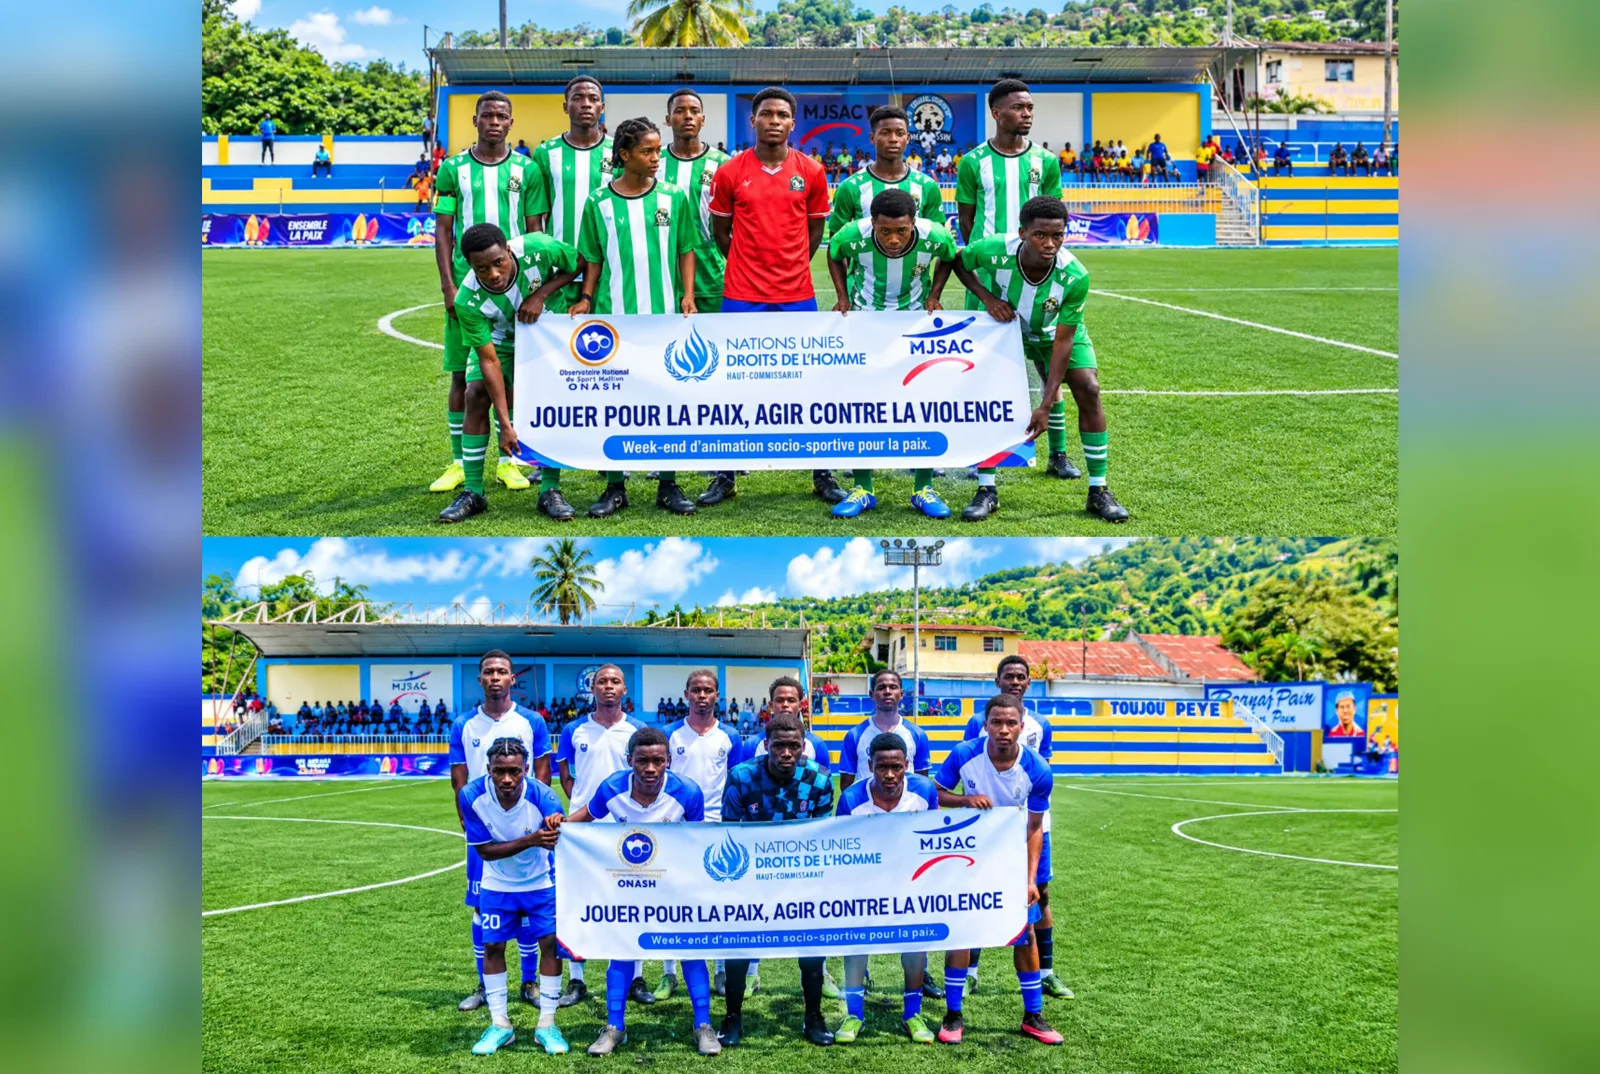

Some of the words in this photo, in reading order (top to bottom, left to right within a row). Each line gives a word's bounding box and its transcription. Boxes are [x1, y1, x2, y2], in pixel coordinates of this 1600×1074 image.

[803, 104, 862, 119] MJSAC
[288, 220, 328, 230] ENSEMBLE
[289, 231, 301, 240] LA
[302, 231, 323, 240] PAIX
[726, 337, 796, 350] NATIONS
[801, 336, 844, 349] UNIES
[910, 339, 974, 354] MJSAC
[726, 354, 778, 366] DROITS
[781, 353, 799, 366] DE
[802, 352, 866, 366] L'HOMME
[726, 371, 803, 380] HAUT-COMMISSARIAT
[530, 406, 598, 428] JOUER
[604, 405, 661, 427] POUR
[667, 404, 691, 426] LA
[697, 403, 750, 428] PAIX,
[755, 403, 803, 425] AGIR
[809, 402, 887, 424] CONTRE
[893, 402, 916, 423] LA
[920, 400, 1014, 423] VIOLENCE
[622, 440, 686, 454] Week-end
[690, 440, 764, 453] d'animation
[767, 438, 855, 453] socio-sportive
[858, 440, 884, 453] pour
[888, 438, 899, 450] la
[902, 438, 931, 453] paix.
[392, 682, 427, 691] MJSAC
[1110, 701, 1165, 716] TOUJOU
[1176, 702, 1220, 716] PEYE
[755, 839, 818, 854] NATIONS
[821, 837, 861, 851] UNIES
[920, 836, 976, 850] MJSAC
[755, 855, 801, 869] DROITS
[804, 854, 820, 867] DE
[823, 852, 882, 866] L'HOMME
[617, 879, 656, 888] ONASH
[580, 905, 640, 923] JOUER
[644, 905, 693, 923] POUR
[698, 905, 721, 922] LA
[724, 903, 769, 923] PAIX,
[773, 902, 815, 920] AGIR
[819, 897, 889, 918] CONTRE
[893, 896, 915, 915] LA
[918, 892, 1003, 914] VIOLENCE
[481, 913, 501, 929] 20
[651, 935, 708, 945] Week-end
[712, 933, 780, 944] d'animation
[783, 930, 866, 943] socio-sportive
[869, 931, 895, 941] pour
[898, 928, 909, 938] la
[912, 927, 938, 939] paix.
